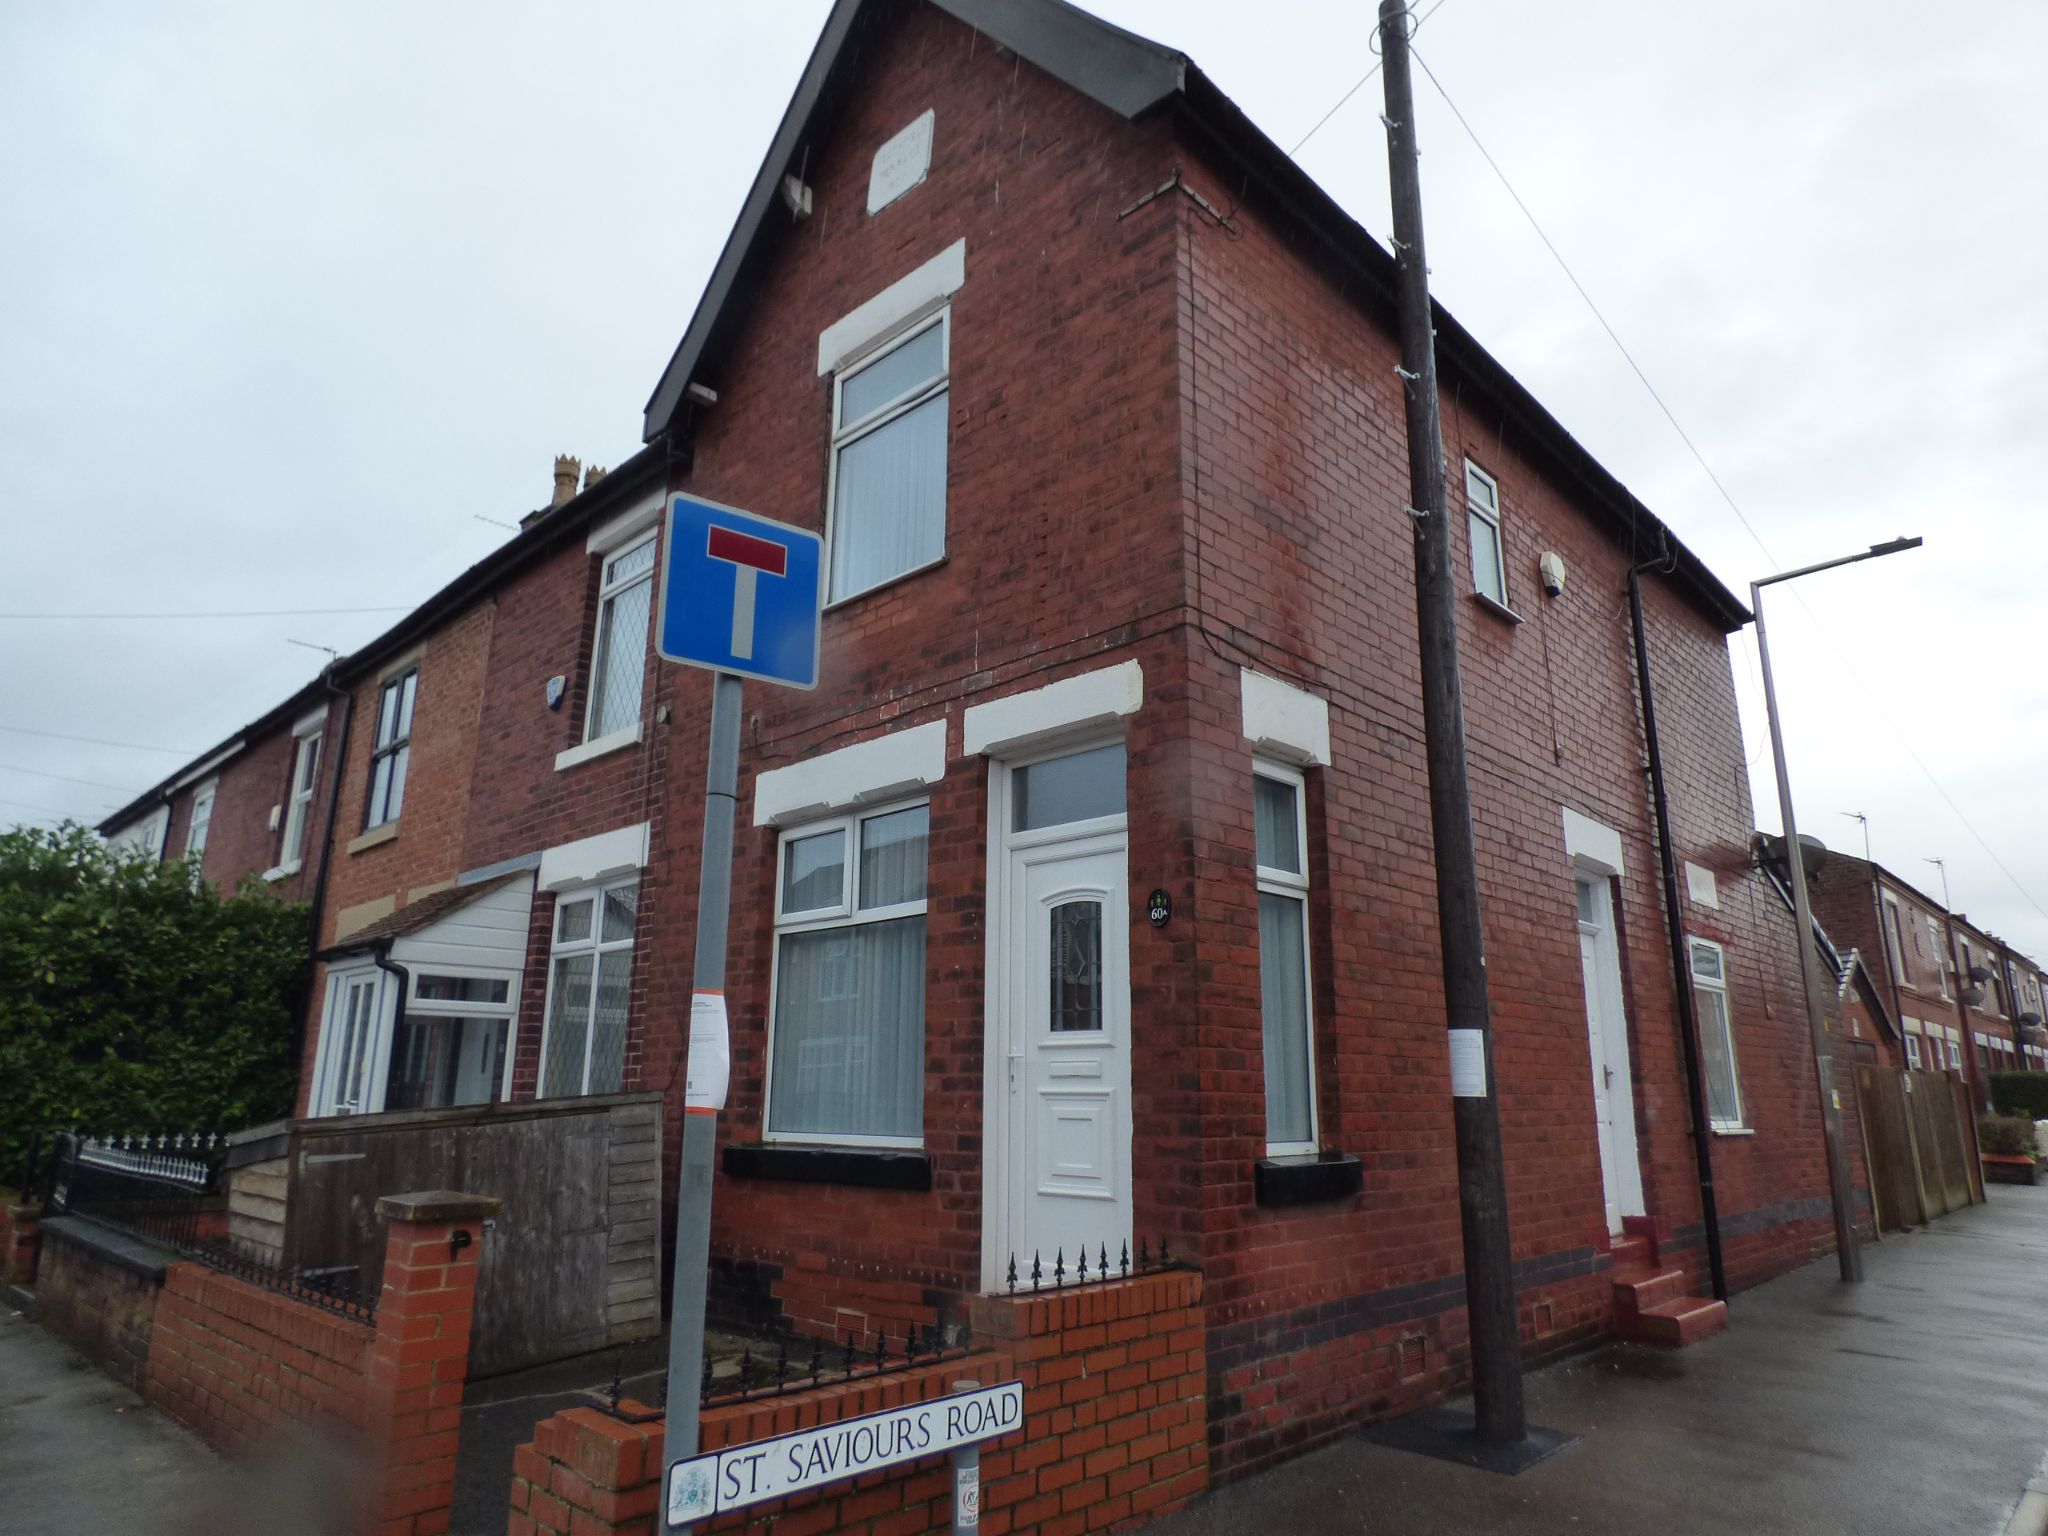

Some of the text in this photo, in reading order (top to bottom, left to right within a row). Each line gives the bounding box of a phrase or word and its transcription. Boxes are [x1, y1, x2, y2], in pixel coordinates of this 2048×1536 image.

[724, 1392, 1018, 1500] ST. SAVIOURS ROAD
